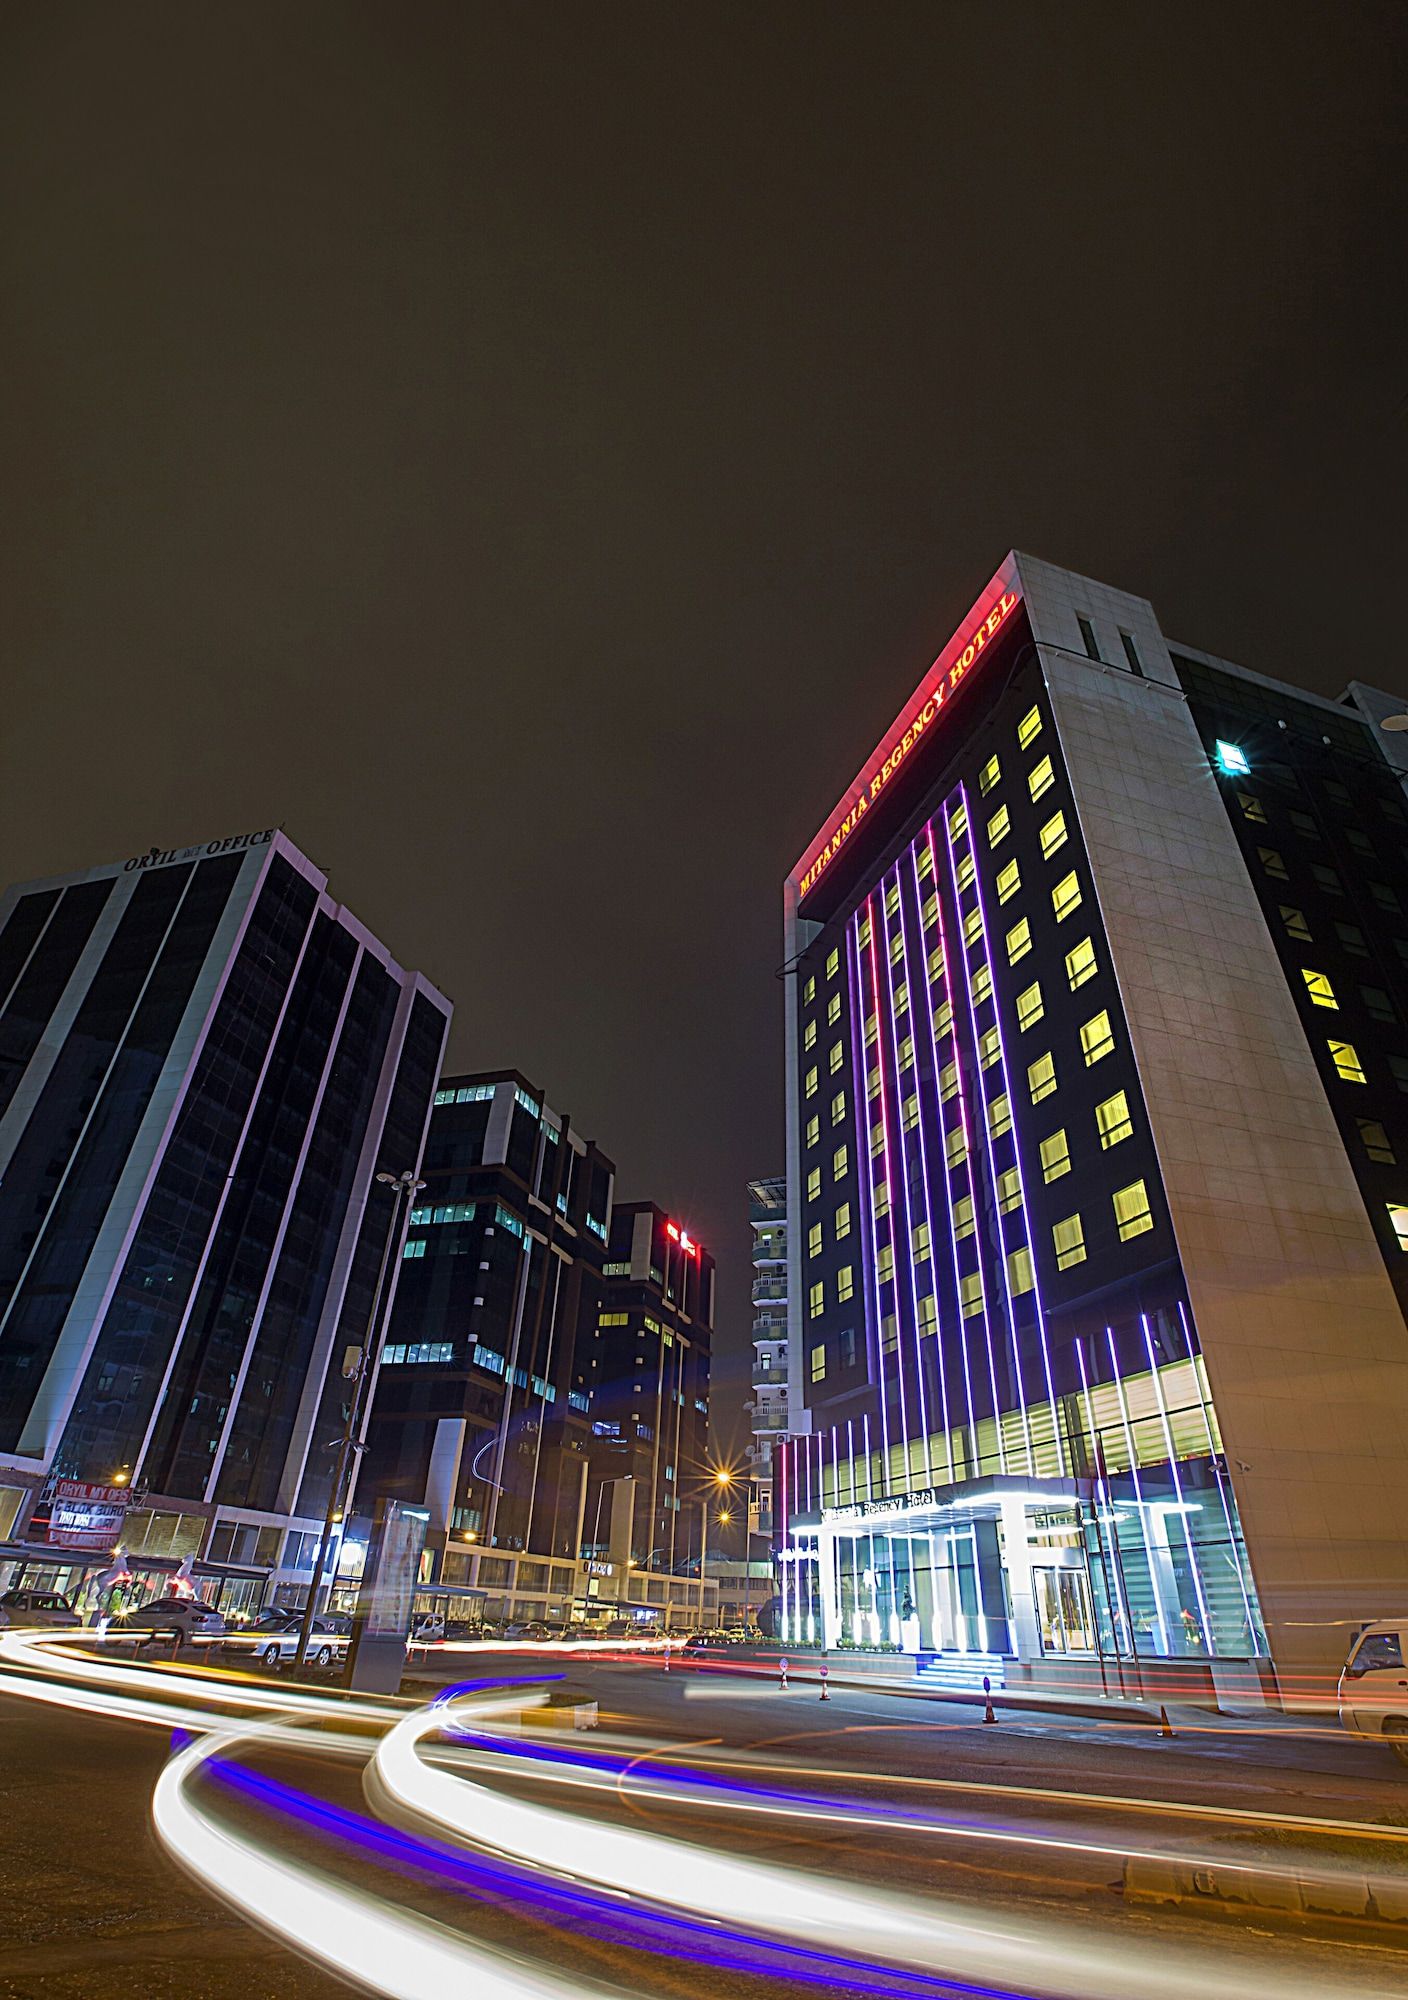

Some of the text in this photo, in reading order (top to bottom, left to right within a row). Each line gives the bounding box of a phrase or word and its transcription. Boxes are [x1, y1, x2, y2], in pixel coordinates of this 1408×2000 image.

[800, 594, 1016, 897] MITANNIA REGENCY HOTEL
[206, 829, 274, 855] OFFICE
[59, 1481, 88, 1498] ORYIL
[88, 1486, 107, 1500] MY
[907, 1489, 935, 1508] Hotel
[55, 1499, 63, 1511] C
